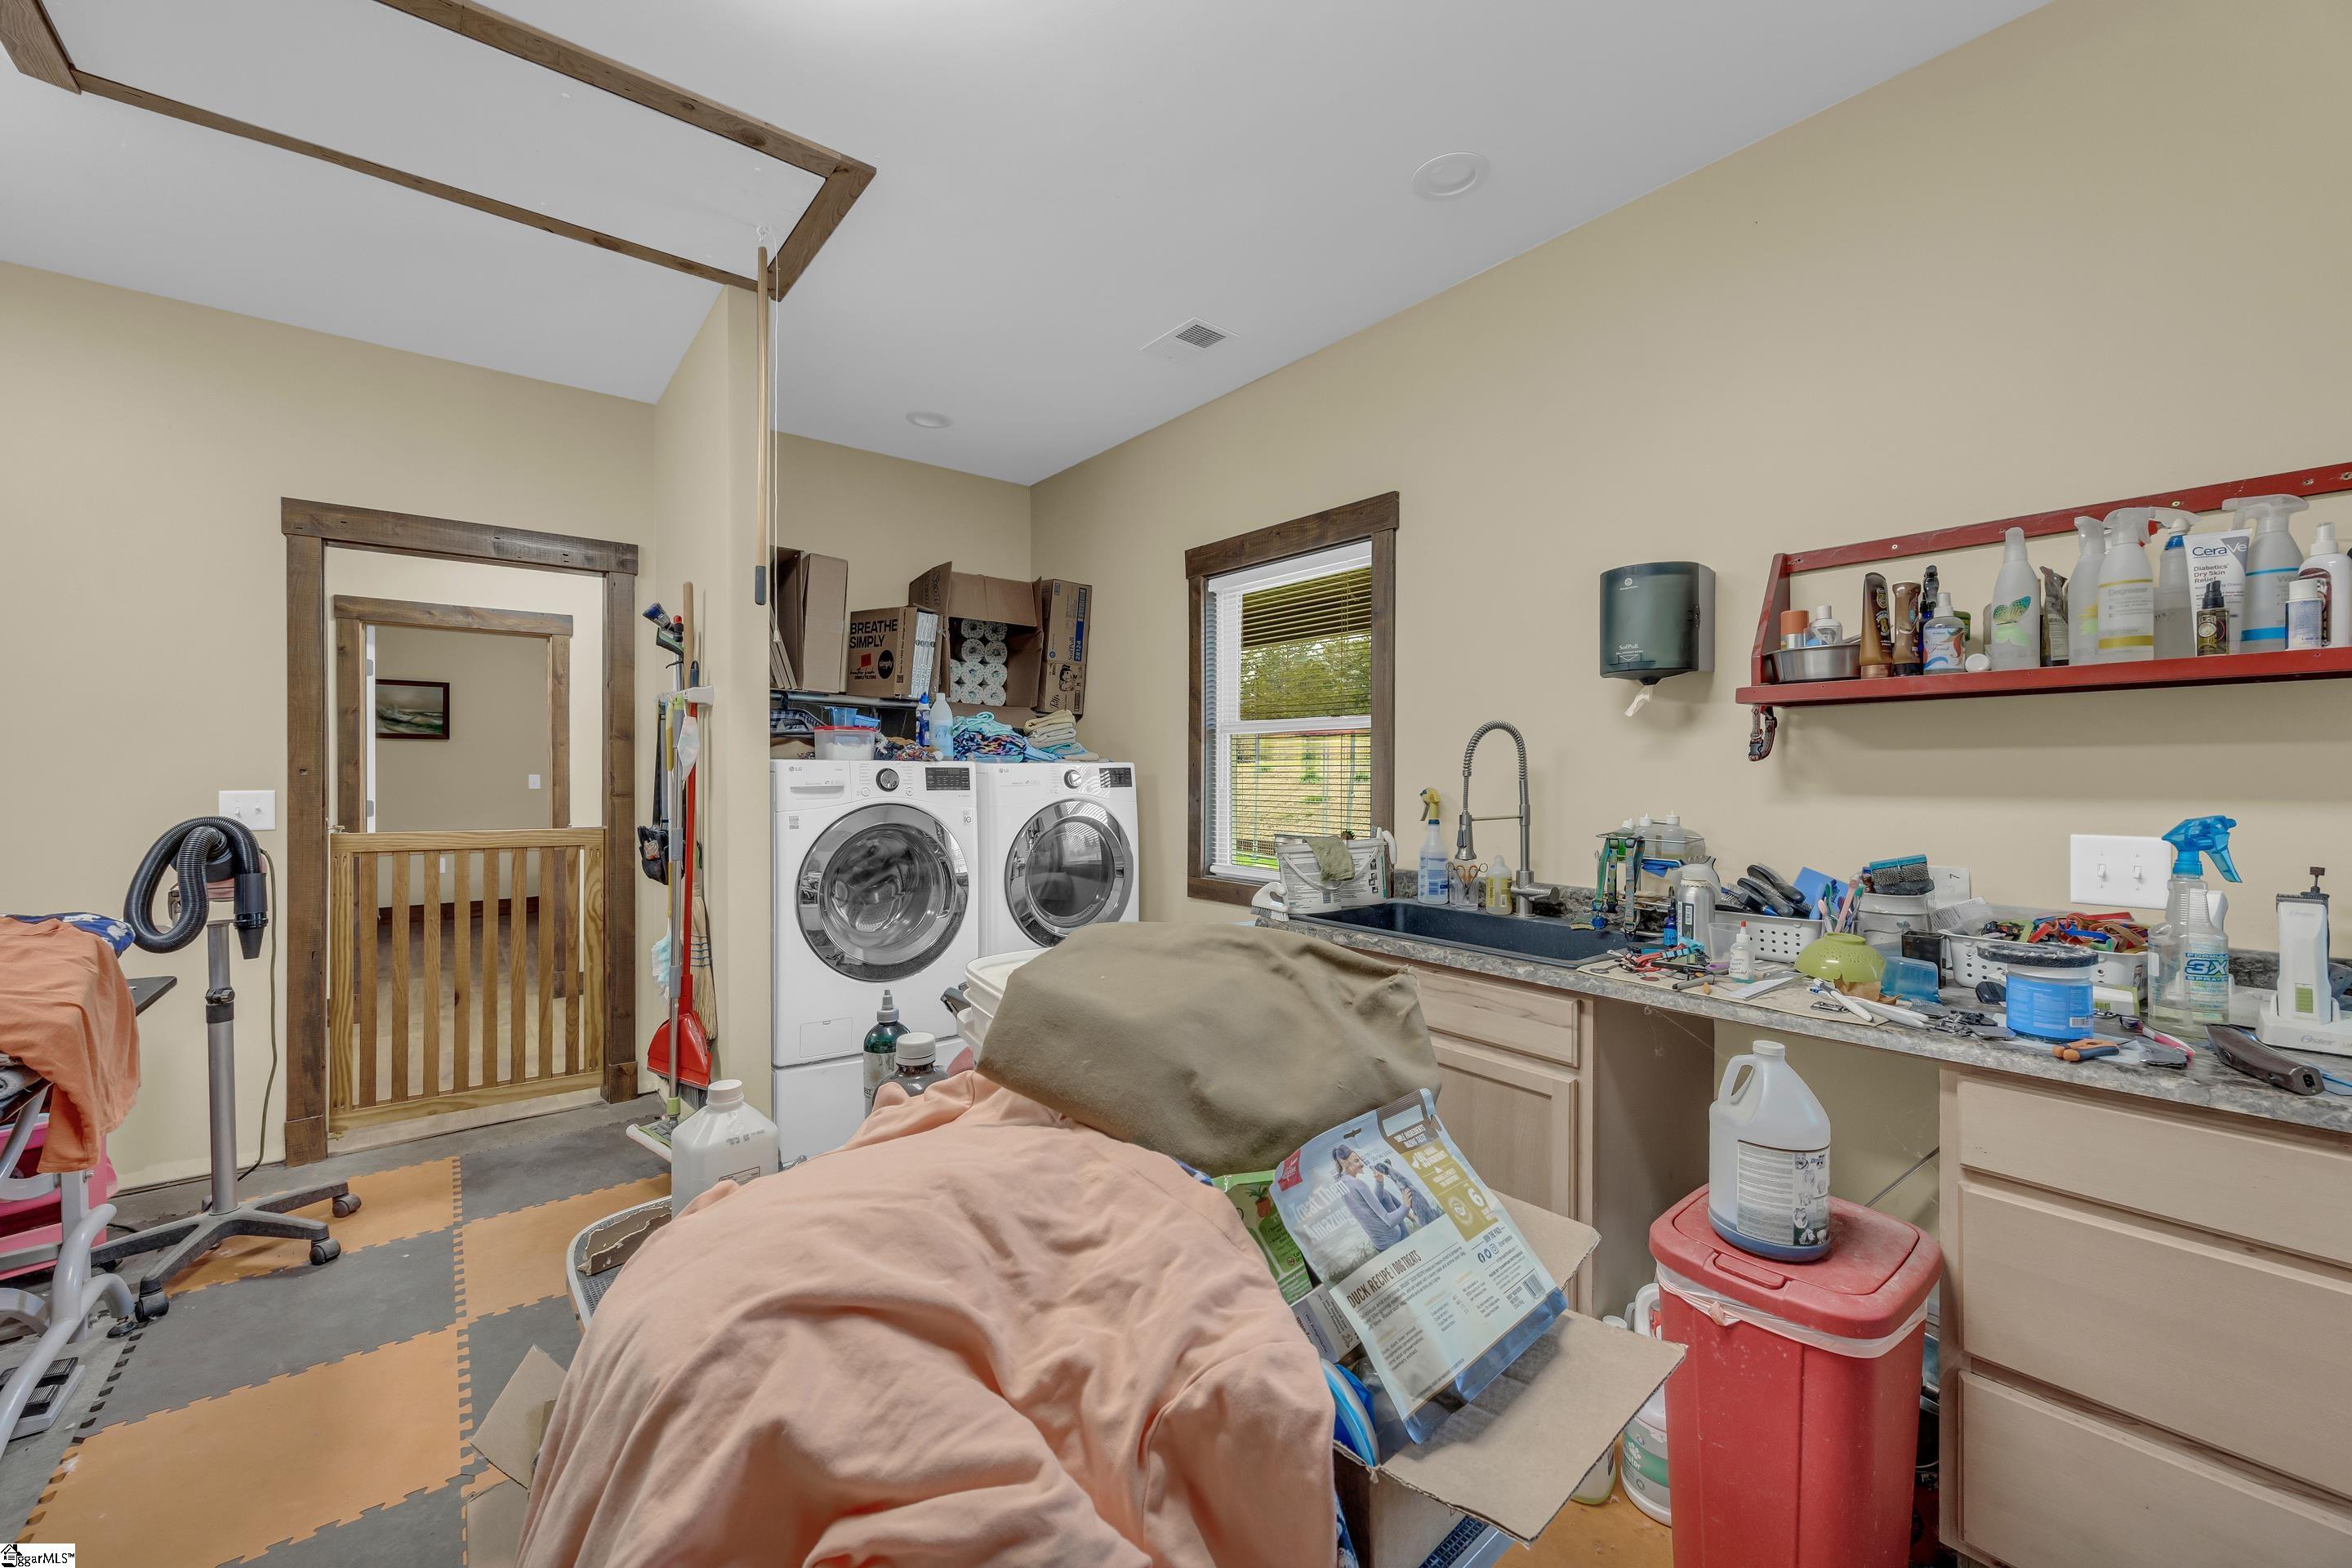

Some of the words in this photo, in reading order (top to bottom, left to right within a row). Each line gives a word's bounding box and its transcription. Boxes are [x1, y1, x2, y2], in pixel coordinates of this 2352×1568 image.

[2192, 541, 2247, 556] CeraVe
[850, 619, 898, 635] BREATHE
[849, 635, 885, 649] SIMPLY
[879, 659, 893, 669] simply
[1050, 694, 1060, 709] Puffs
[2185, 959, 2228, 976] 3X
[2300, 1035, 2335, 1046] Oster
[1289, 1195, 1319, 1223] Treat
[1313, 1180, 1350, 1209] Them
[1468, 1187, 1485, 1207] 6
[1303, 1207, 1356, 1241] Amazing
[1347, 1283, 1371, 1308] DUCK
[1367, 1267, 1395, 1293] RECIPE
[1392, 1258, 1405, 1275] DOG
[1401, 1250, 1422, 1269] TREATS
[1309, 1323, 1328, 1354] Horticultural
